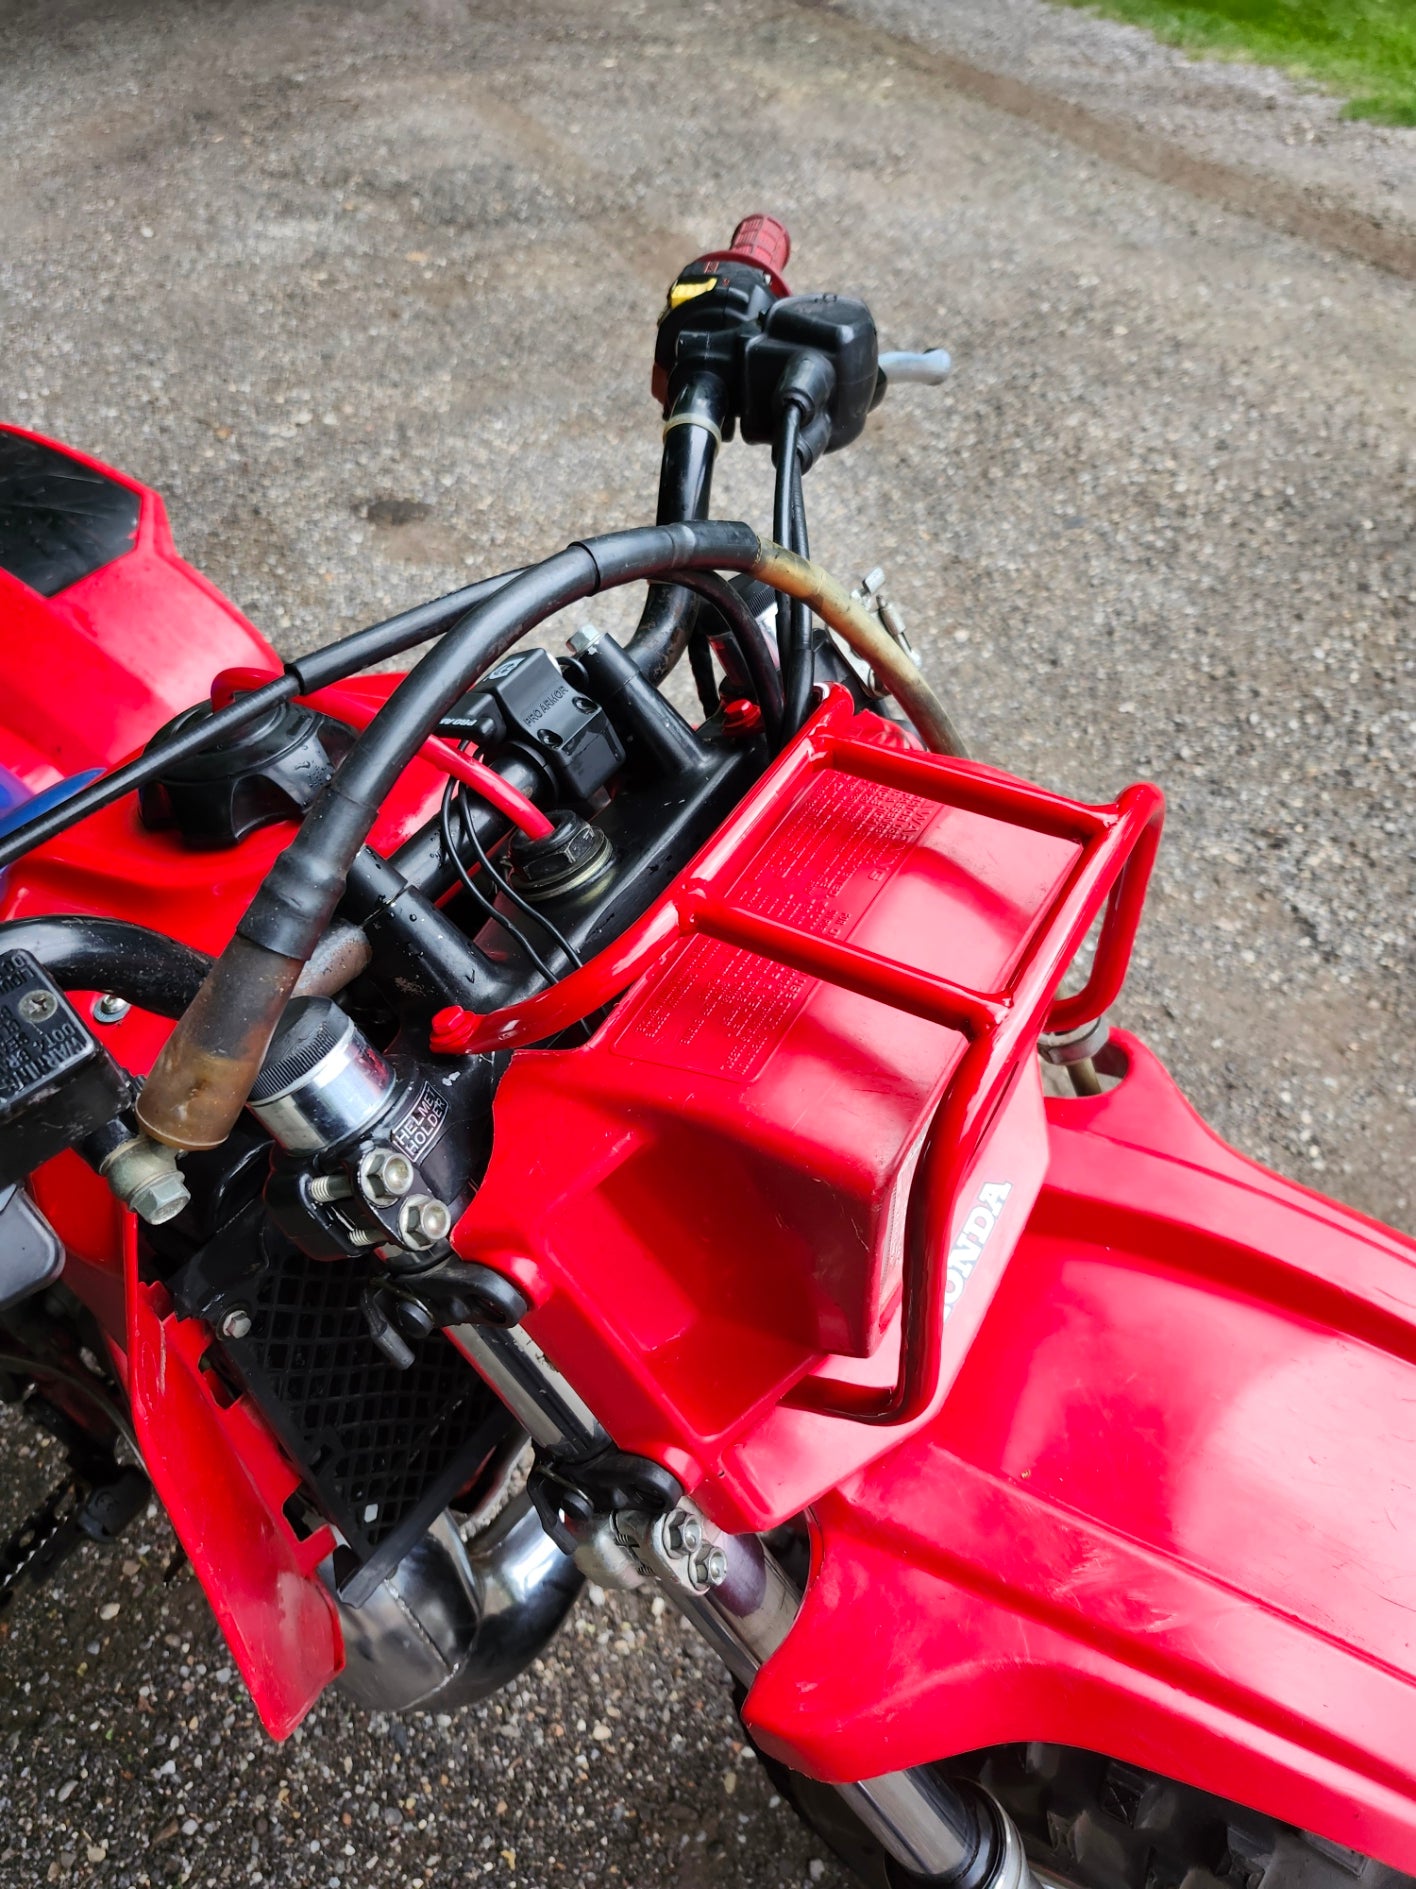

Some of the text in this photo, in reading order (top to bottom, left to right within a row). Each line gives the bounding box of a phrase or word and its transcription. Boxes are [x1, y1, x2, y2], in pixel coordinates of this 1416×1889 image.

[522, 685, 569, 727] PRO ARMOR
[395, 1087, 435, 1146] HELMET
[405, 1097, 445, 1156] HOLDER
[943, 1180, 1014, 1325] ONDA
